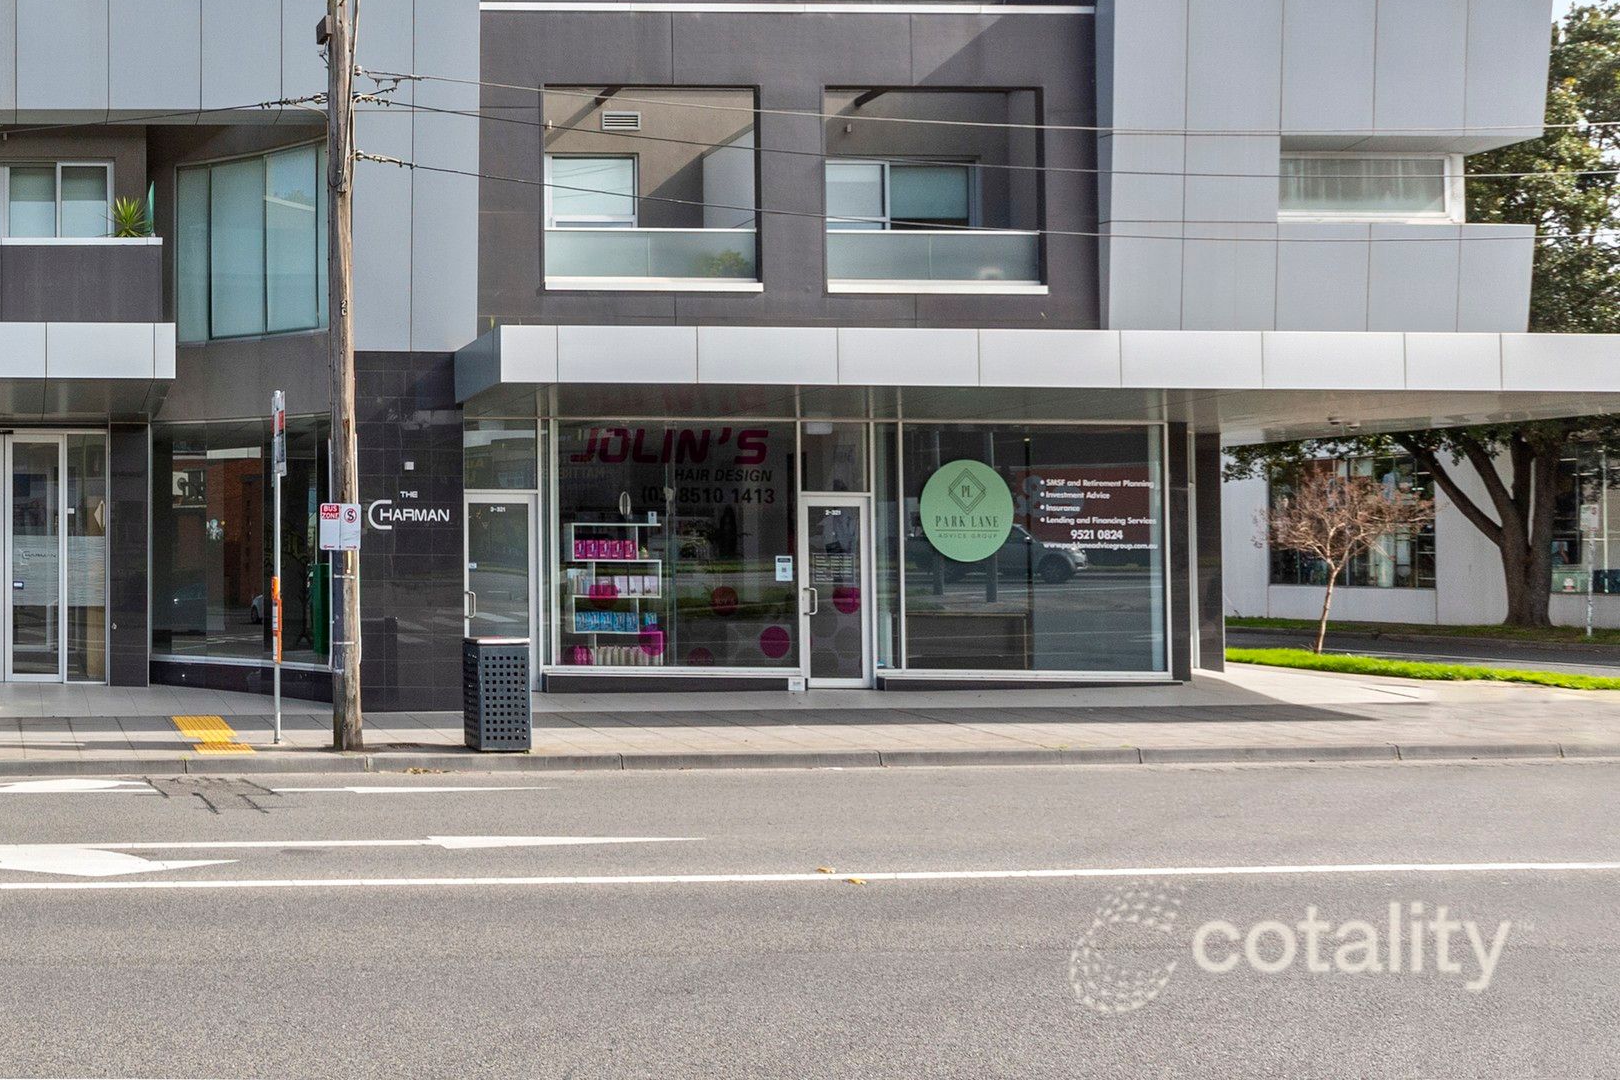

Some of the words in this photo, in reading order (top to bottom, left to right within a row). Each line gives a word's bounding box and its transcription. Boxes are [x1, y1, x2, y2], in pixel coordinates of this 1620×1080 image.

[570, 427, 769, 465] JOLIN'S
[675, 470, 710, 482] HAIR
[714, 470, 772, 482] DESIGN
[1046, 479, 1066, 487] SMSF
[1067, 479, 1081, 487] and
[1083, 479, 1121, 487] Retirement
[1123, 480, 1154, 489] Planning
[400, 490, 418, 498] THE
[680, 486, 723, 503] 8510
[732, 487, 775, 504] 1413
[1046, 491, 1085, 499] Investment
[1086, 491, 1110, 499] Advice
[1046, 504, 1081, 512] Insurance
[322, 512, 339, 520] ZONE
[368, 499, 450, 530] CHARMAN
[935, 515, 966, 528] PARK
[971, 515, 1000, 528] LANE
[1046, 517, 1075, 525] Lending
[1092, 517, 1126, 526] Financing
[1127, 517, 1157, 525] Services
[1070, 529, 1095, 540] 9521
[1097, 529, 1124, 540] 0824
